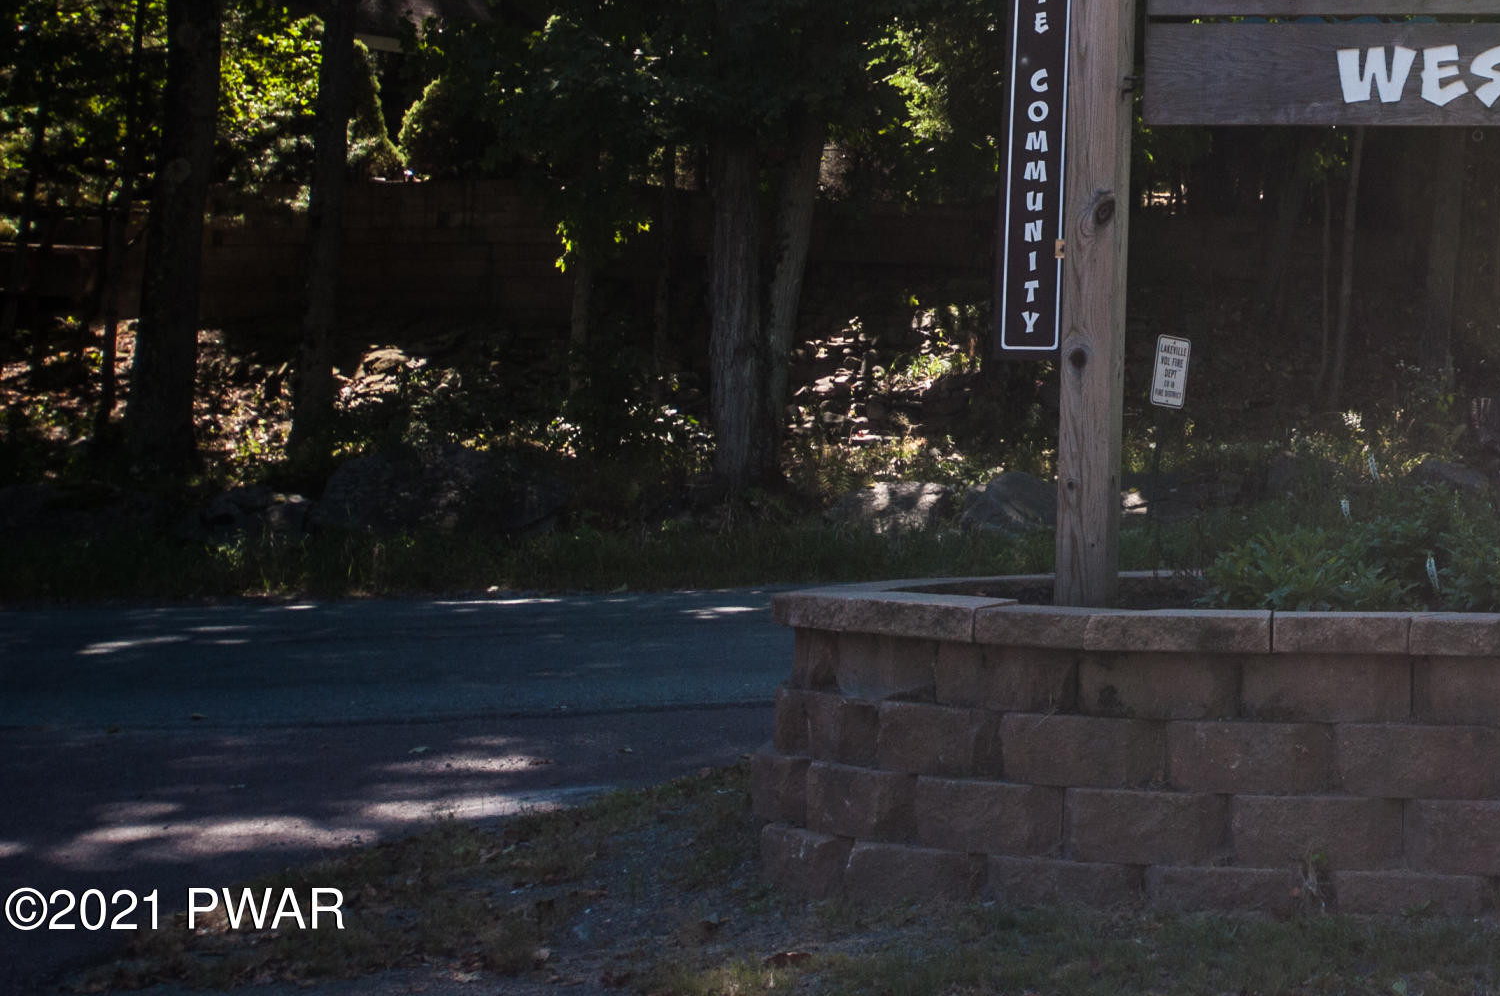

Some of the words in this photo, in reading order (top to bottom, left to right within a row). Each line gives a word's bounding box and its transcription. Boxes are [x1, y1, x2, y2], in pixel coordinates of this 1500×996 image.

[1021, 67, 1049, 334] COMMUNITY
[1160, 344, 1187, 357] LAKEVILLE
[1171, 357, 1184, 369] FIRE
